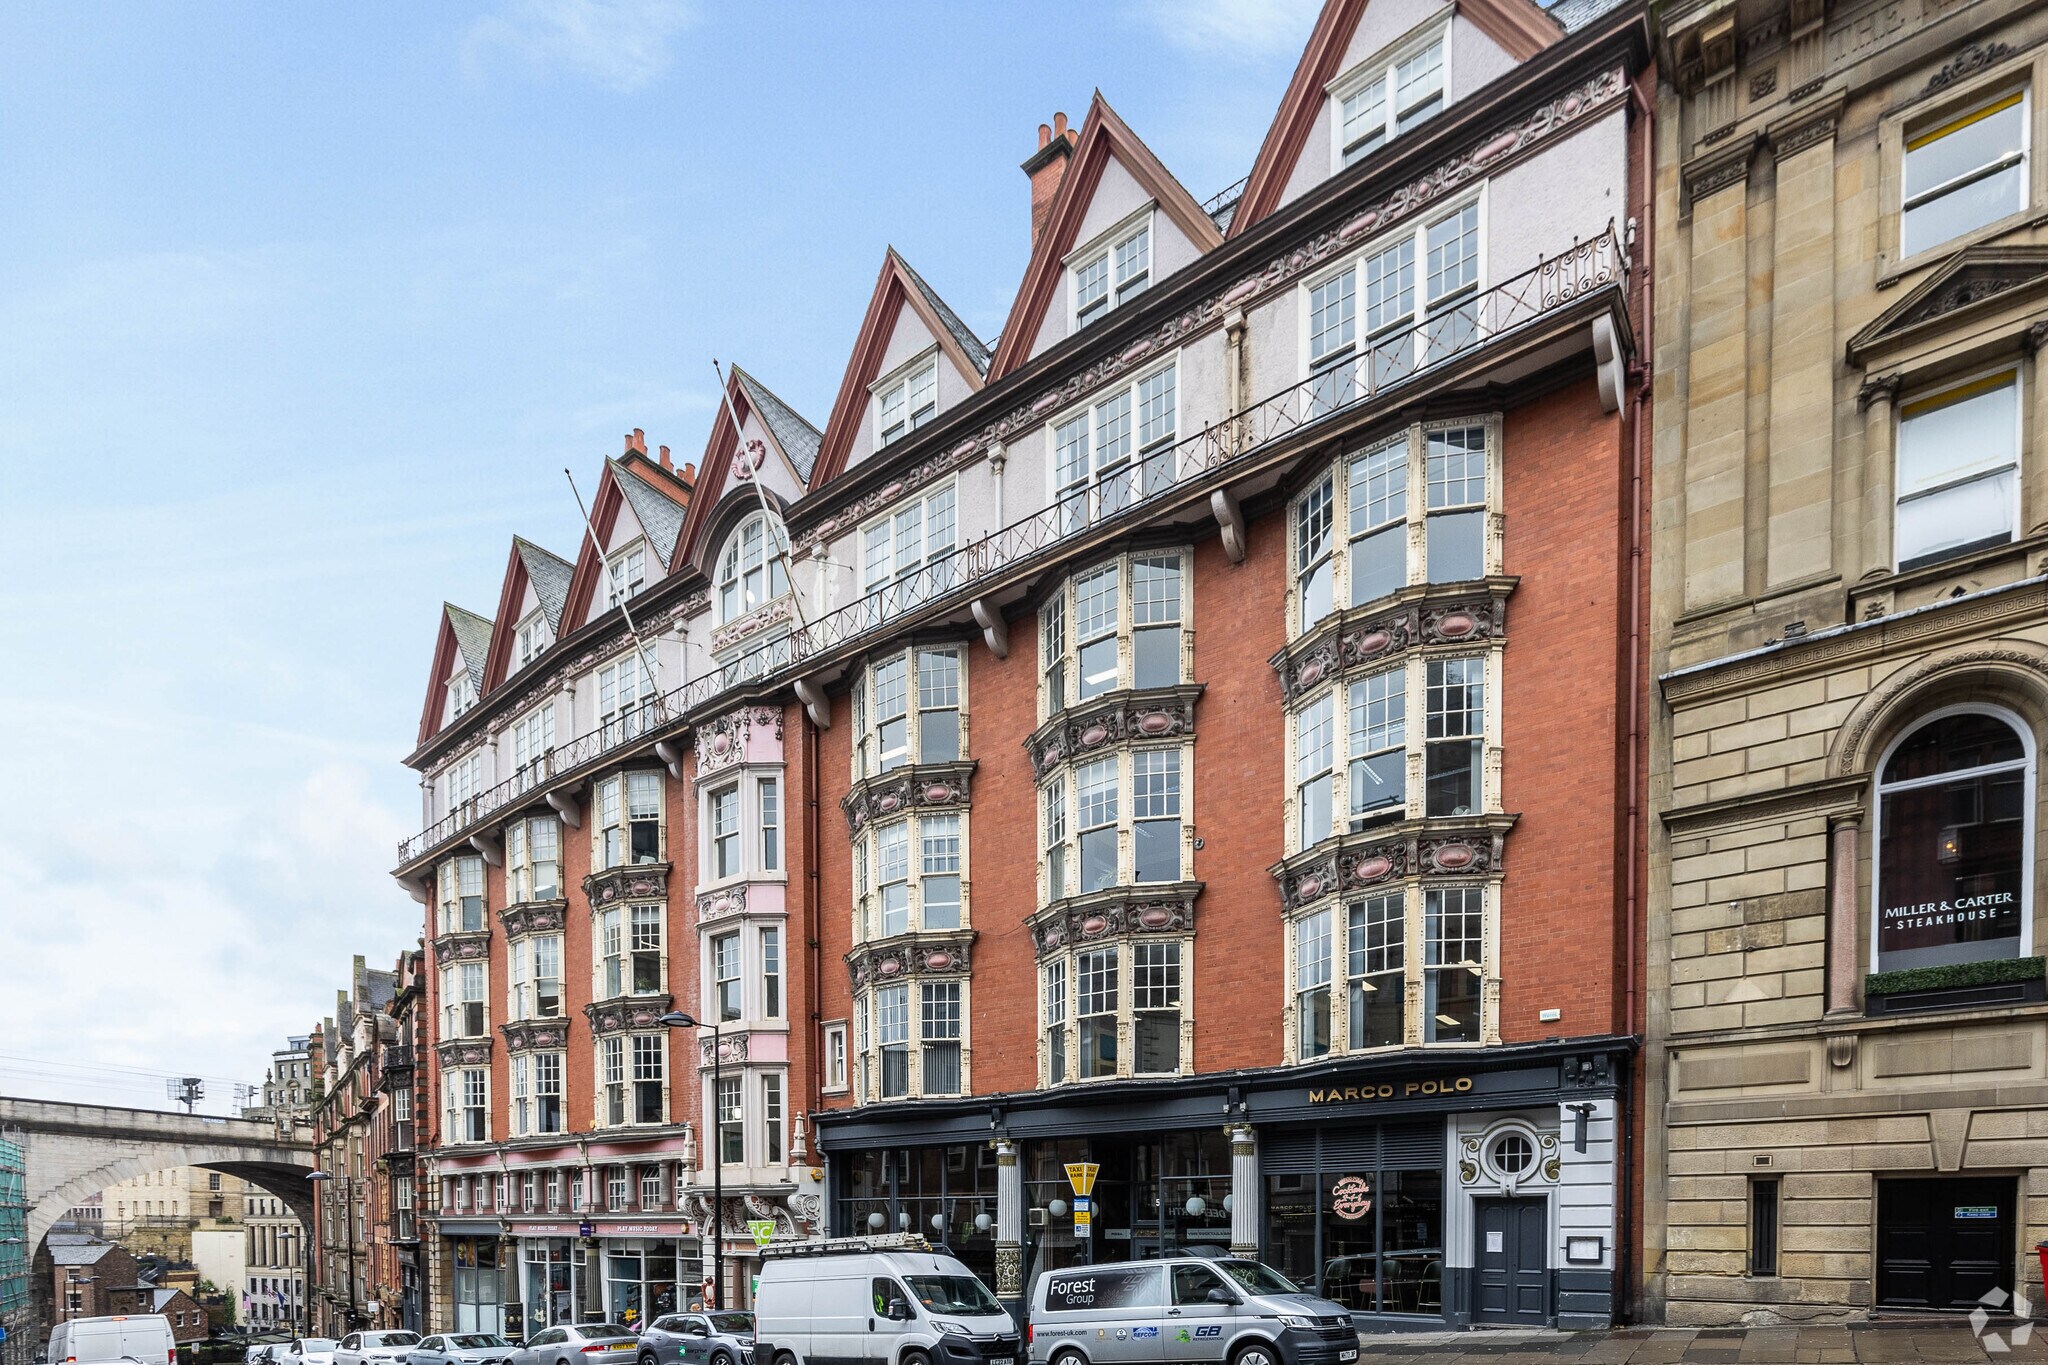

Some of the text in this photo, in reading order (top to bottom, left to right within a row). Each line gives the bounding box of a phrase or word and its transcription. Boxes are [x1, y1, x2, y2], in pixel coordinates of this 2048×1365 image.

[1885, 892, 2013, 918] MILLER & CARTER
[1897, 908, 1996, 930] STEAKHOUSE
[1309, 1077, 1473, 1103] MARCO POLO
[1050, 1278, 1096, 1295] Forest
[1066, 1294, 1095, 1305] Group
[1195, 1326, 1222, 1337] GB
